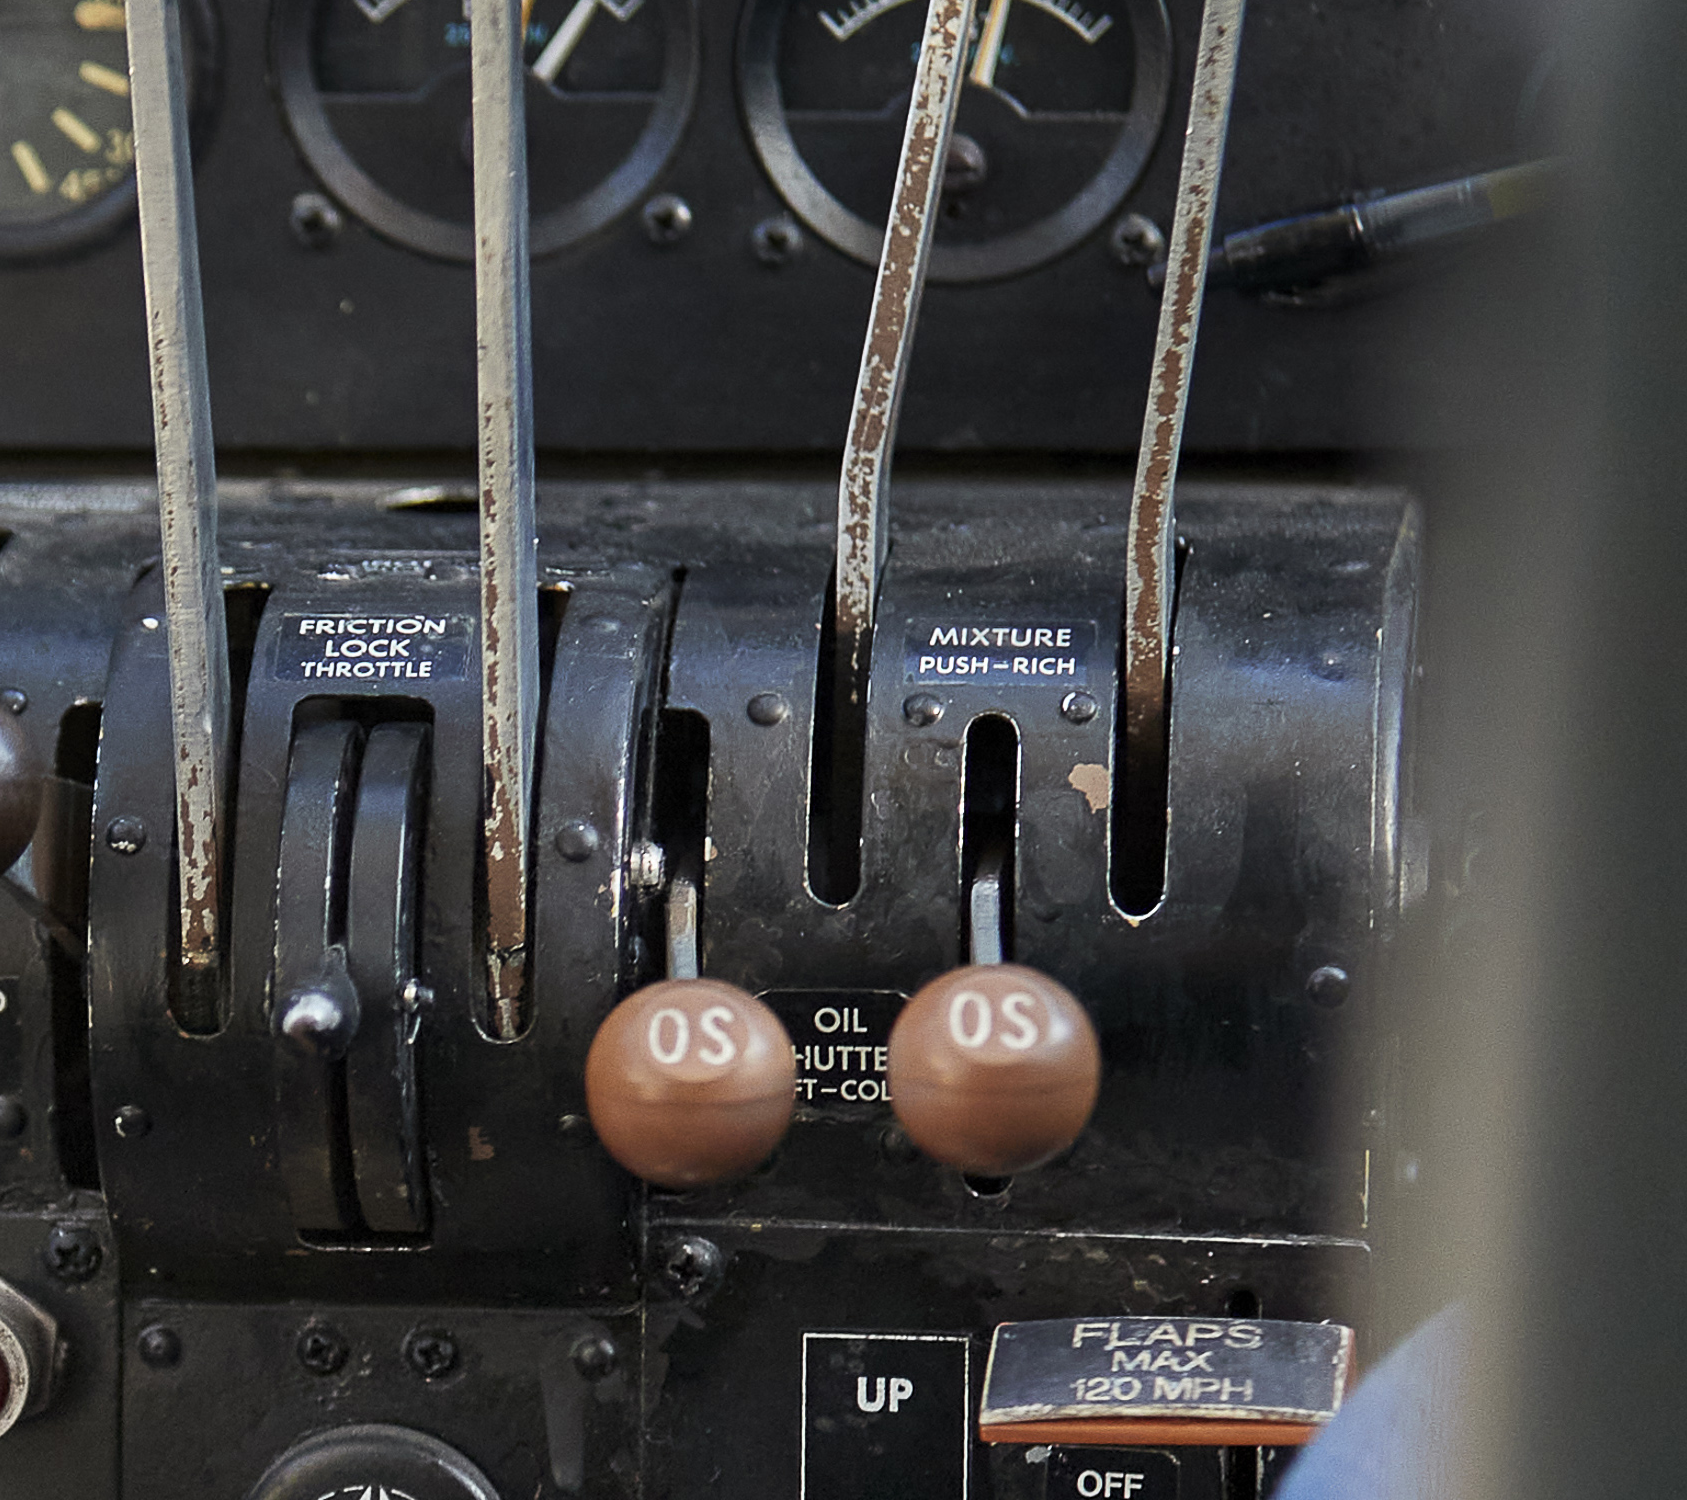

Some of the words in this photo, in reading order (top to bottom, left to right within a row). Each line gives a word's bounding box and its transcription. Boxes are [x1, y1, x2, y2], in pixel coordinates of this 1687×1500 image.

[299, 618, 447, 635] FRICTION
[928, 627, 1072, 648] MIXTURE
[325, 639, 411, 658] LOCK
[301, 661, 432, 678] THROTTLE
[814, 1007, 867, 1033] OIL
[948, 991, 1039, 1049] OS
[648, 1005, 736, 1065] OS
[1072, 1322, 1263, 1350] FLAPS
[1111, 1351, 1214, 1372] MAX
[857, 1376, 913, 1413] UP
[1070, 1378, 1143, 1402] 120
[1153, 1378, 1253, 1402] MPH
[1077, 1470, 1145, 1499] OFF
